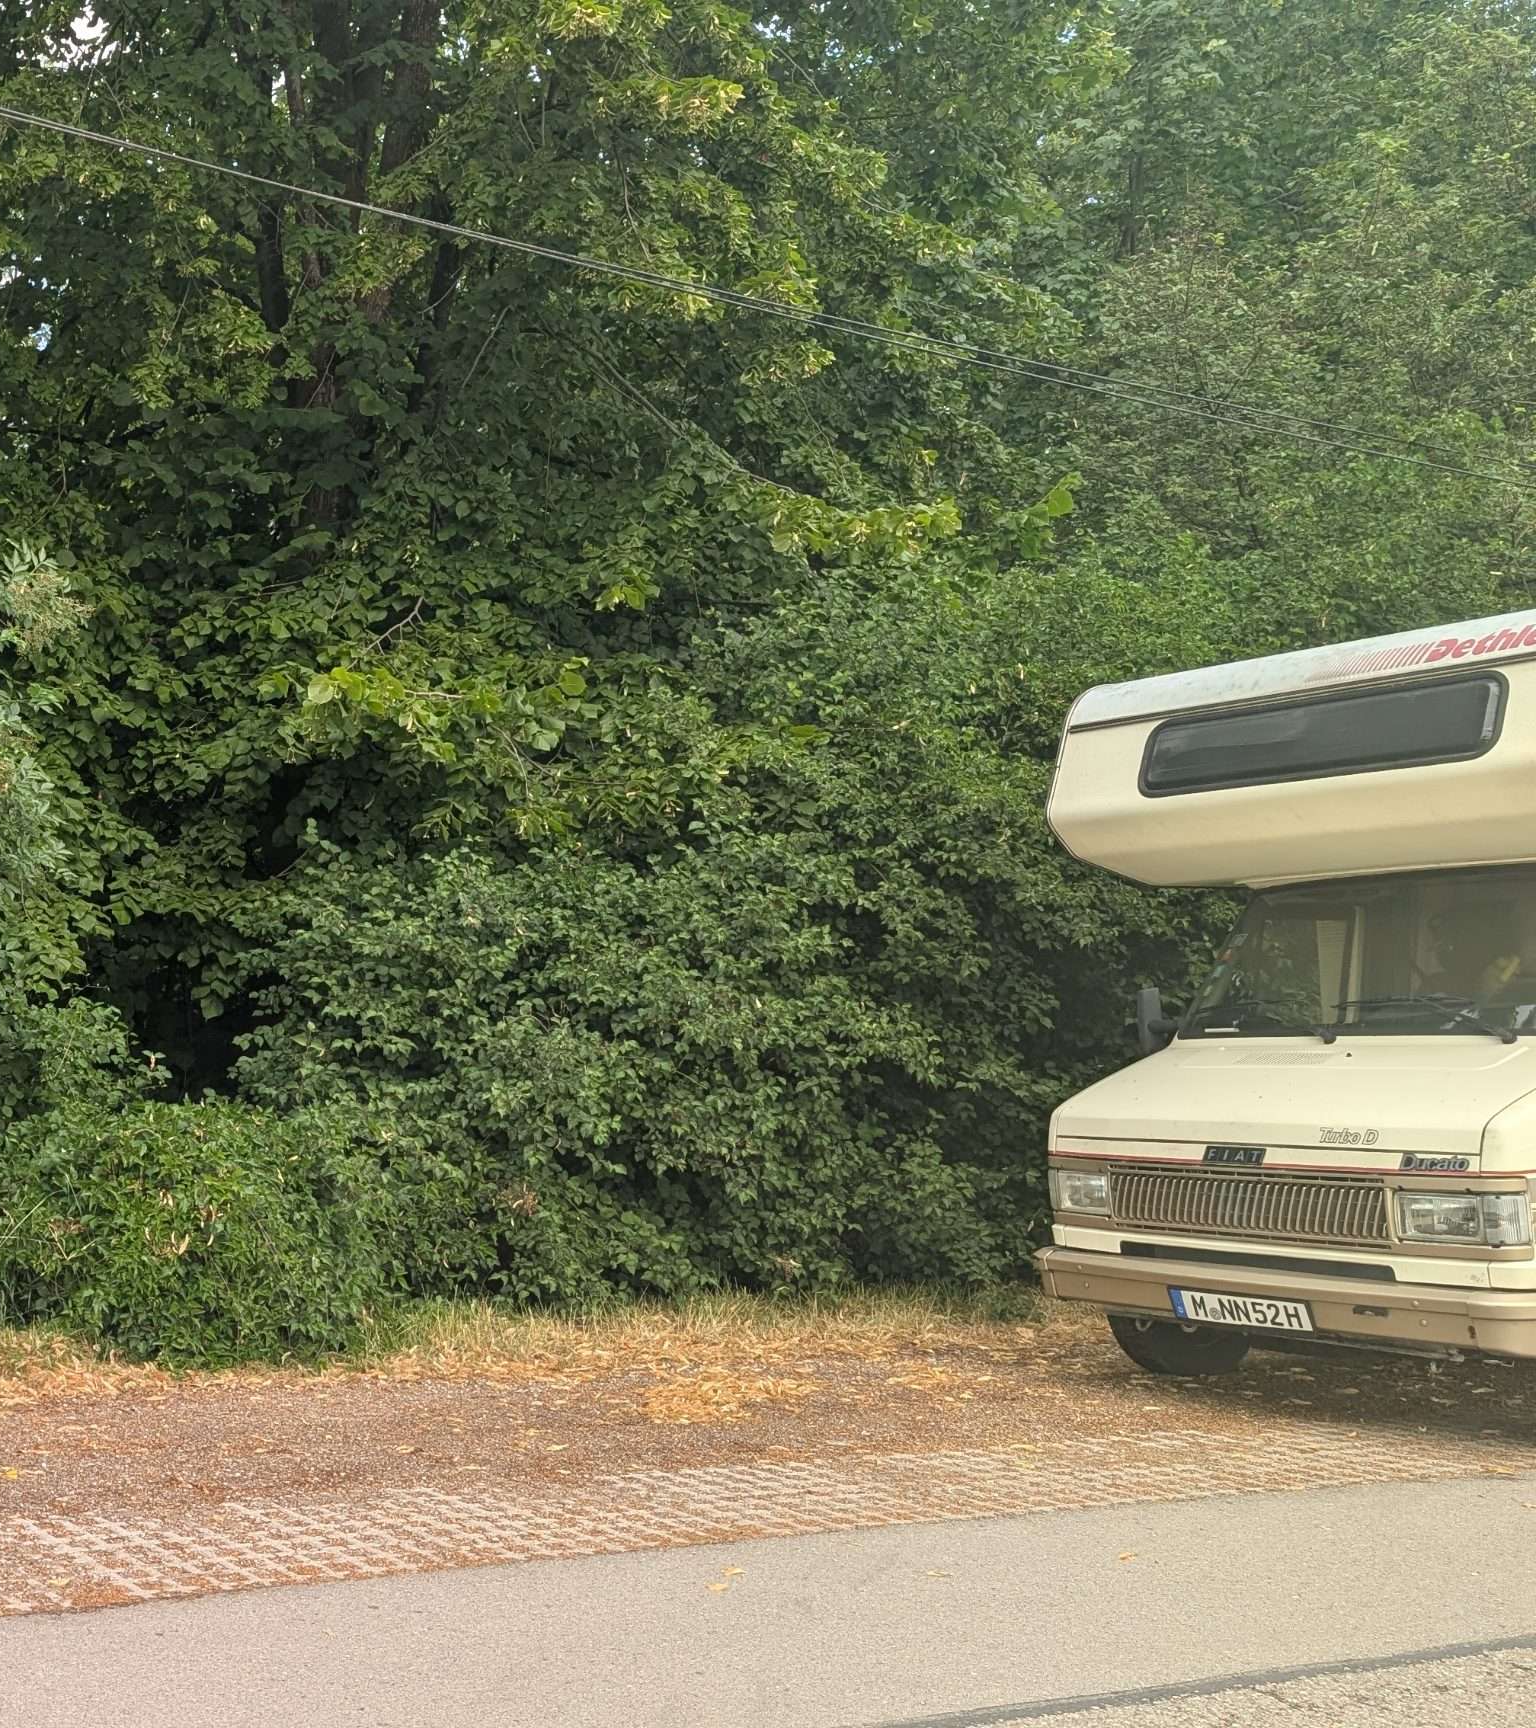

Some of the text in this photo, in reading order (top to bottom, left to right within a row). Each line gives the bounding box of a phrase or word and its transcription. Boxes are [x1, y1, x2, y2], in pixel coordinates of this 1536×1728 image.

[1319, 1127, 1379, 1145] Turbo D
[1207, 1148, 1262, 1162] FIAT
[1399, 1152, 1470, 1172] Ducato
